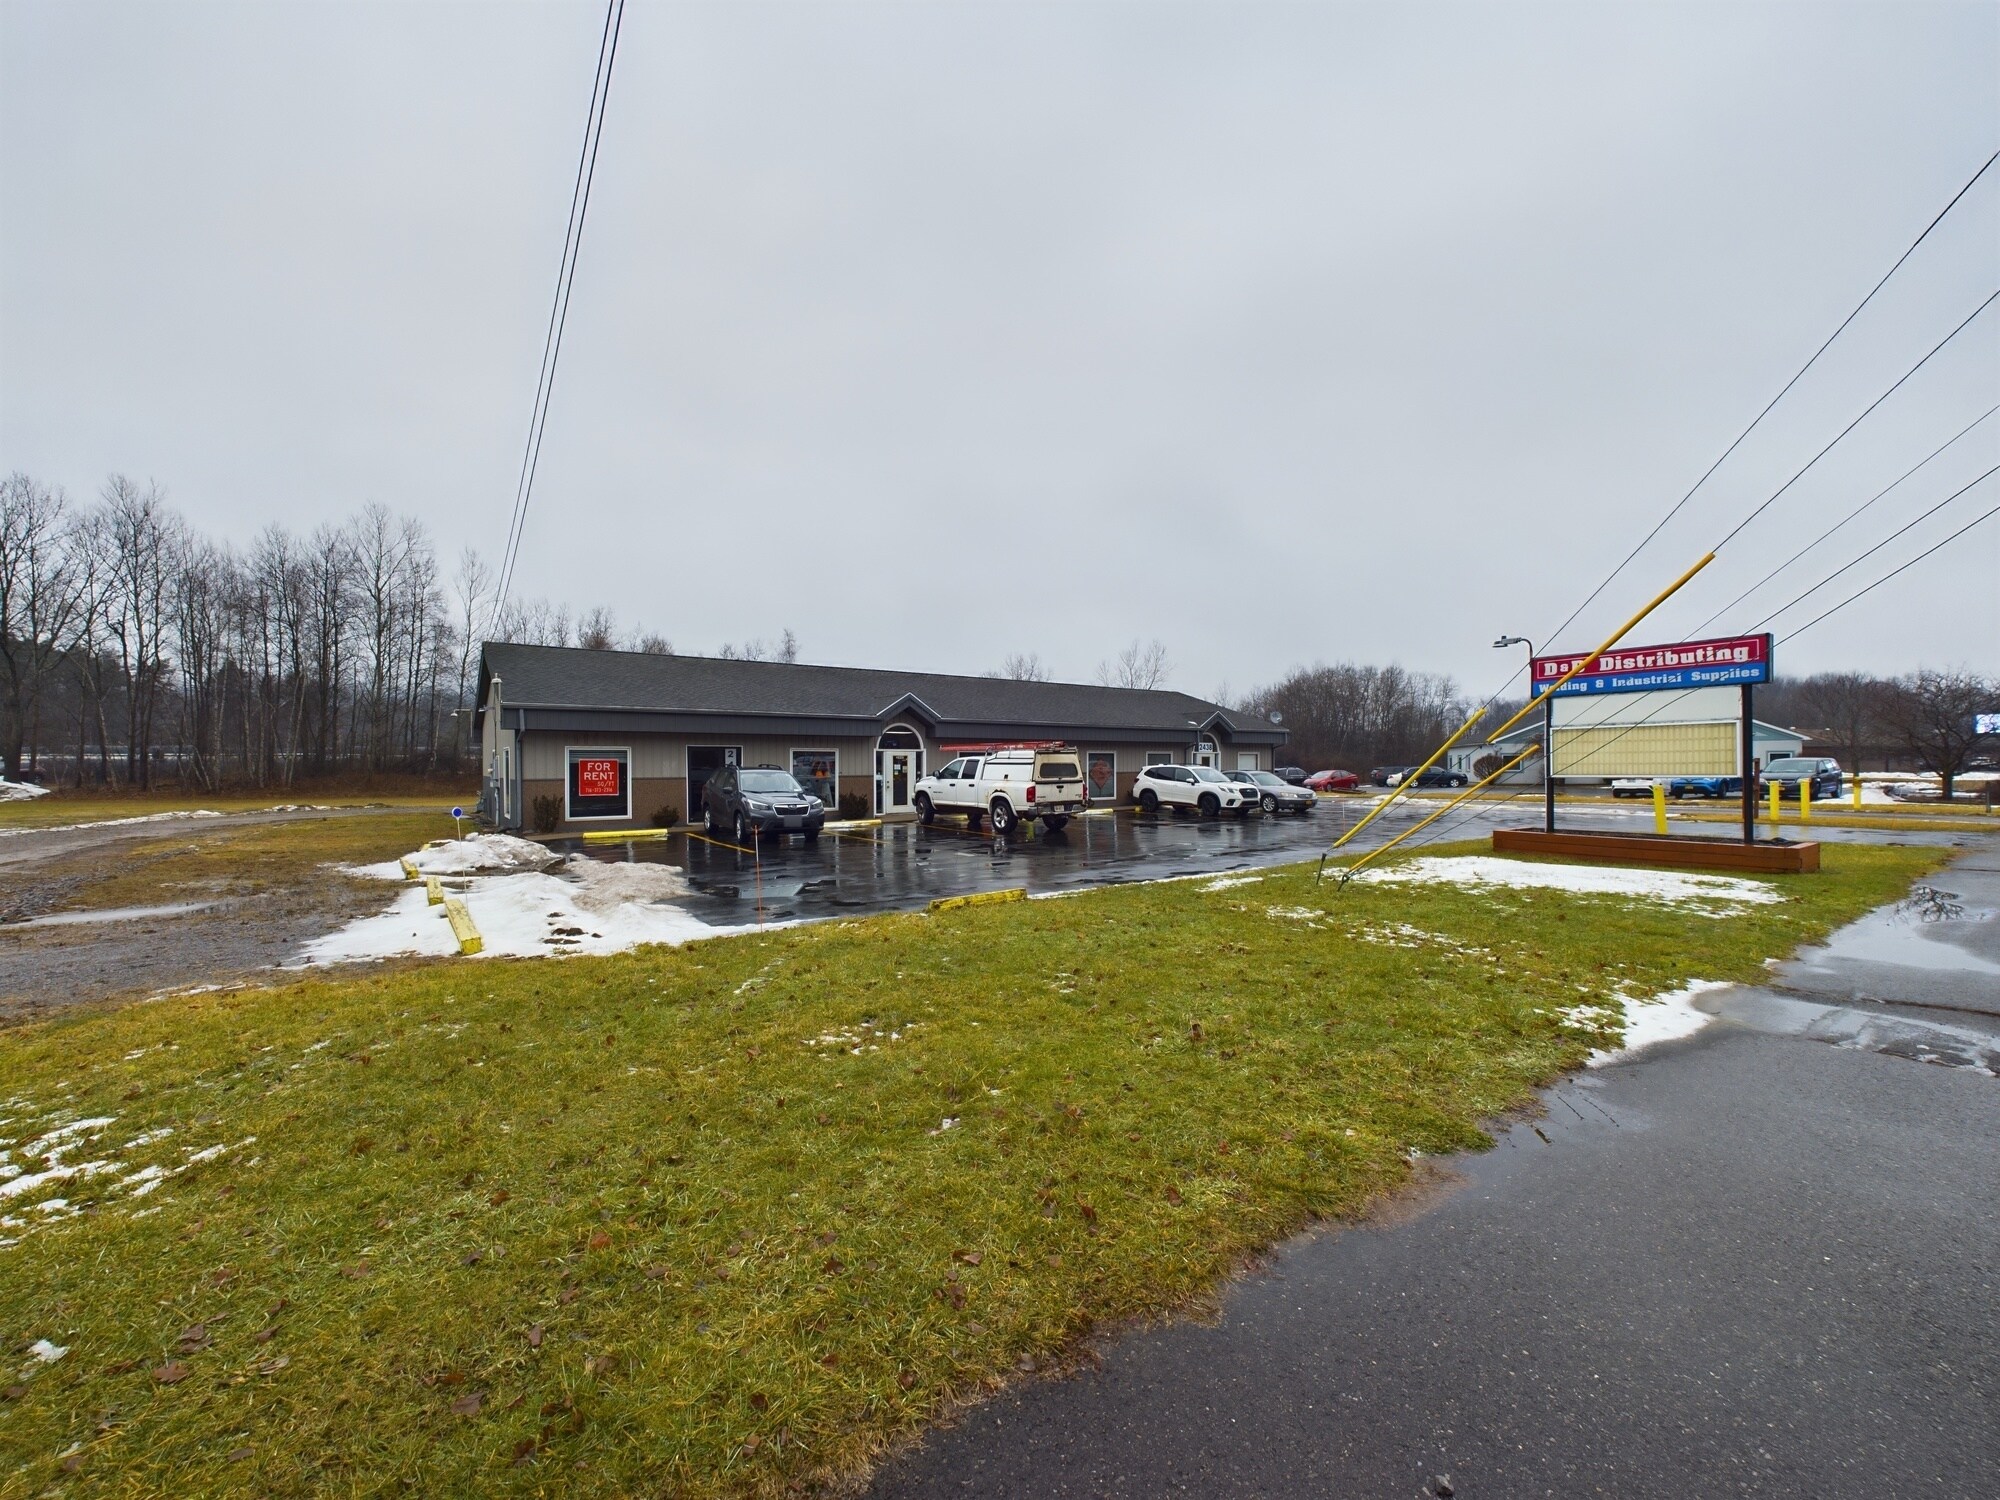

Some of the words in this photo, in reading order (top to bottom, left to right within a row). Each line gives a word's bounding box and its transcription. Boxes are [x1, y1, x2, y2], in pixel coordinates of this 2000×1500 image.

[1600, 646, 1750, 671] Distributing
[1539, 681, 1587, 692] Wding
[1595, 679, 1604, 688] &
[1612, 673, 1682, 687] Industrial
[1691, 668, 1760, 682] Supplies
[587, 762, 611, 771] FOR
[584, 772, 615, 781] RENT
